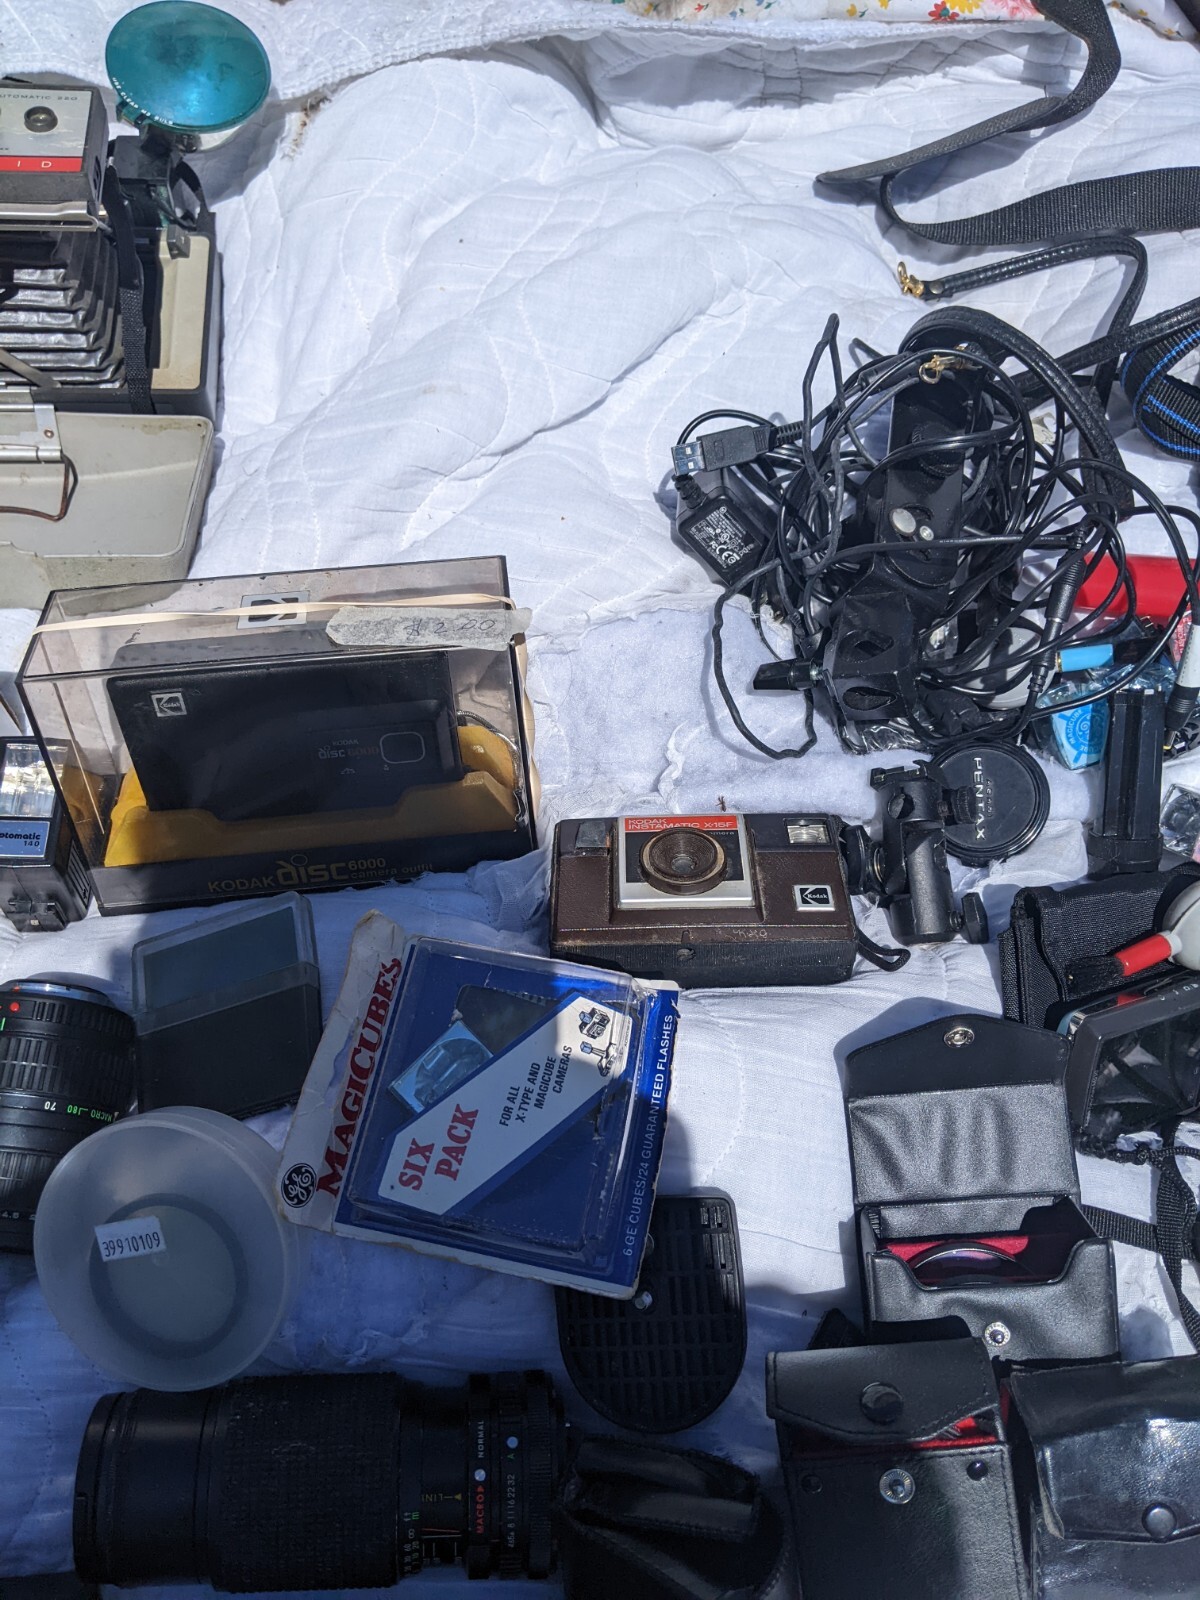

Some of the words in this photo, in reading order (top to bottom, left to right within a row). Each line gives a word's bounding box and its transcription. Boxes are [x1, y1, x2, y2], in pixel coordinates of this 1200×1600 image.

[973, 757, 986, 840] PENTAX
[628, 822, 701, 830] INSTAMATIC
[207, 875, 277, 894] KODAK
[349, 857, 386, 871] 6000
[351, 867, 398, 879] camera
[656, 1014, 673, 1071] FLASHES
[315, 957, 402, 1199] MAGICUBES
[515, 1086, 534, 1124] X-TYPE
[527, 1062, 541, 1086] AND
[533, 1055, 557, 1110] MAGICUBE
[552, 1045, 572, 1095] CAMERAS
[44, 1101, 57, 1111] 70
[499, 1104, 514, 1127] FOR
[507, 1085, 520, 1106] ALL
[641, 1073, 665, 1160] GUARANTEED
[398, 1137, 435, 1191] SIX
[434, 1103, 479, 1181] PACK
[628, 1162, 649, 1224] CUBES/24
[102, 1231, 161, 1258] 39910109
[622, 1247, 633, 1256] 6
[624, 1227, 638, 1246] GE
[477, 1419, 485, 1459] NORMAL
[475, 1491, 485, 1535] MACRO
